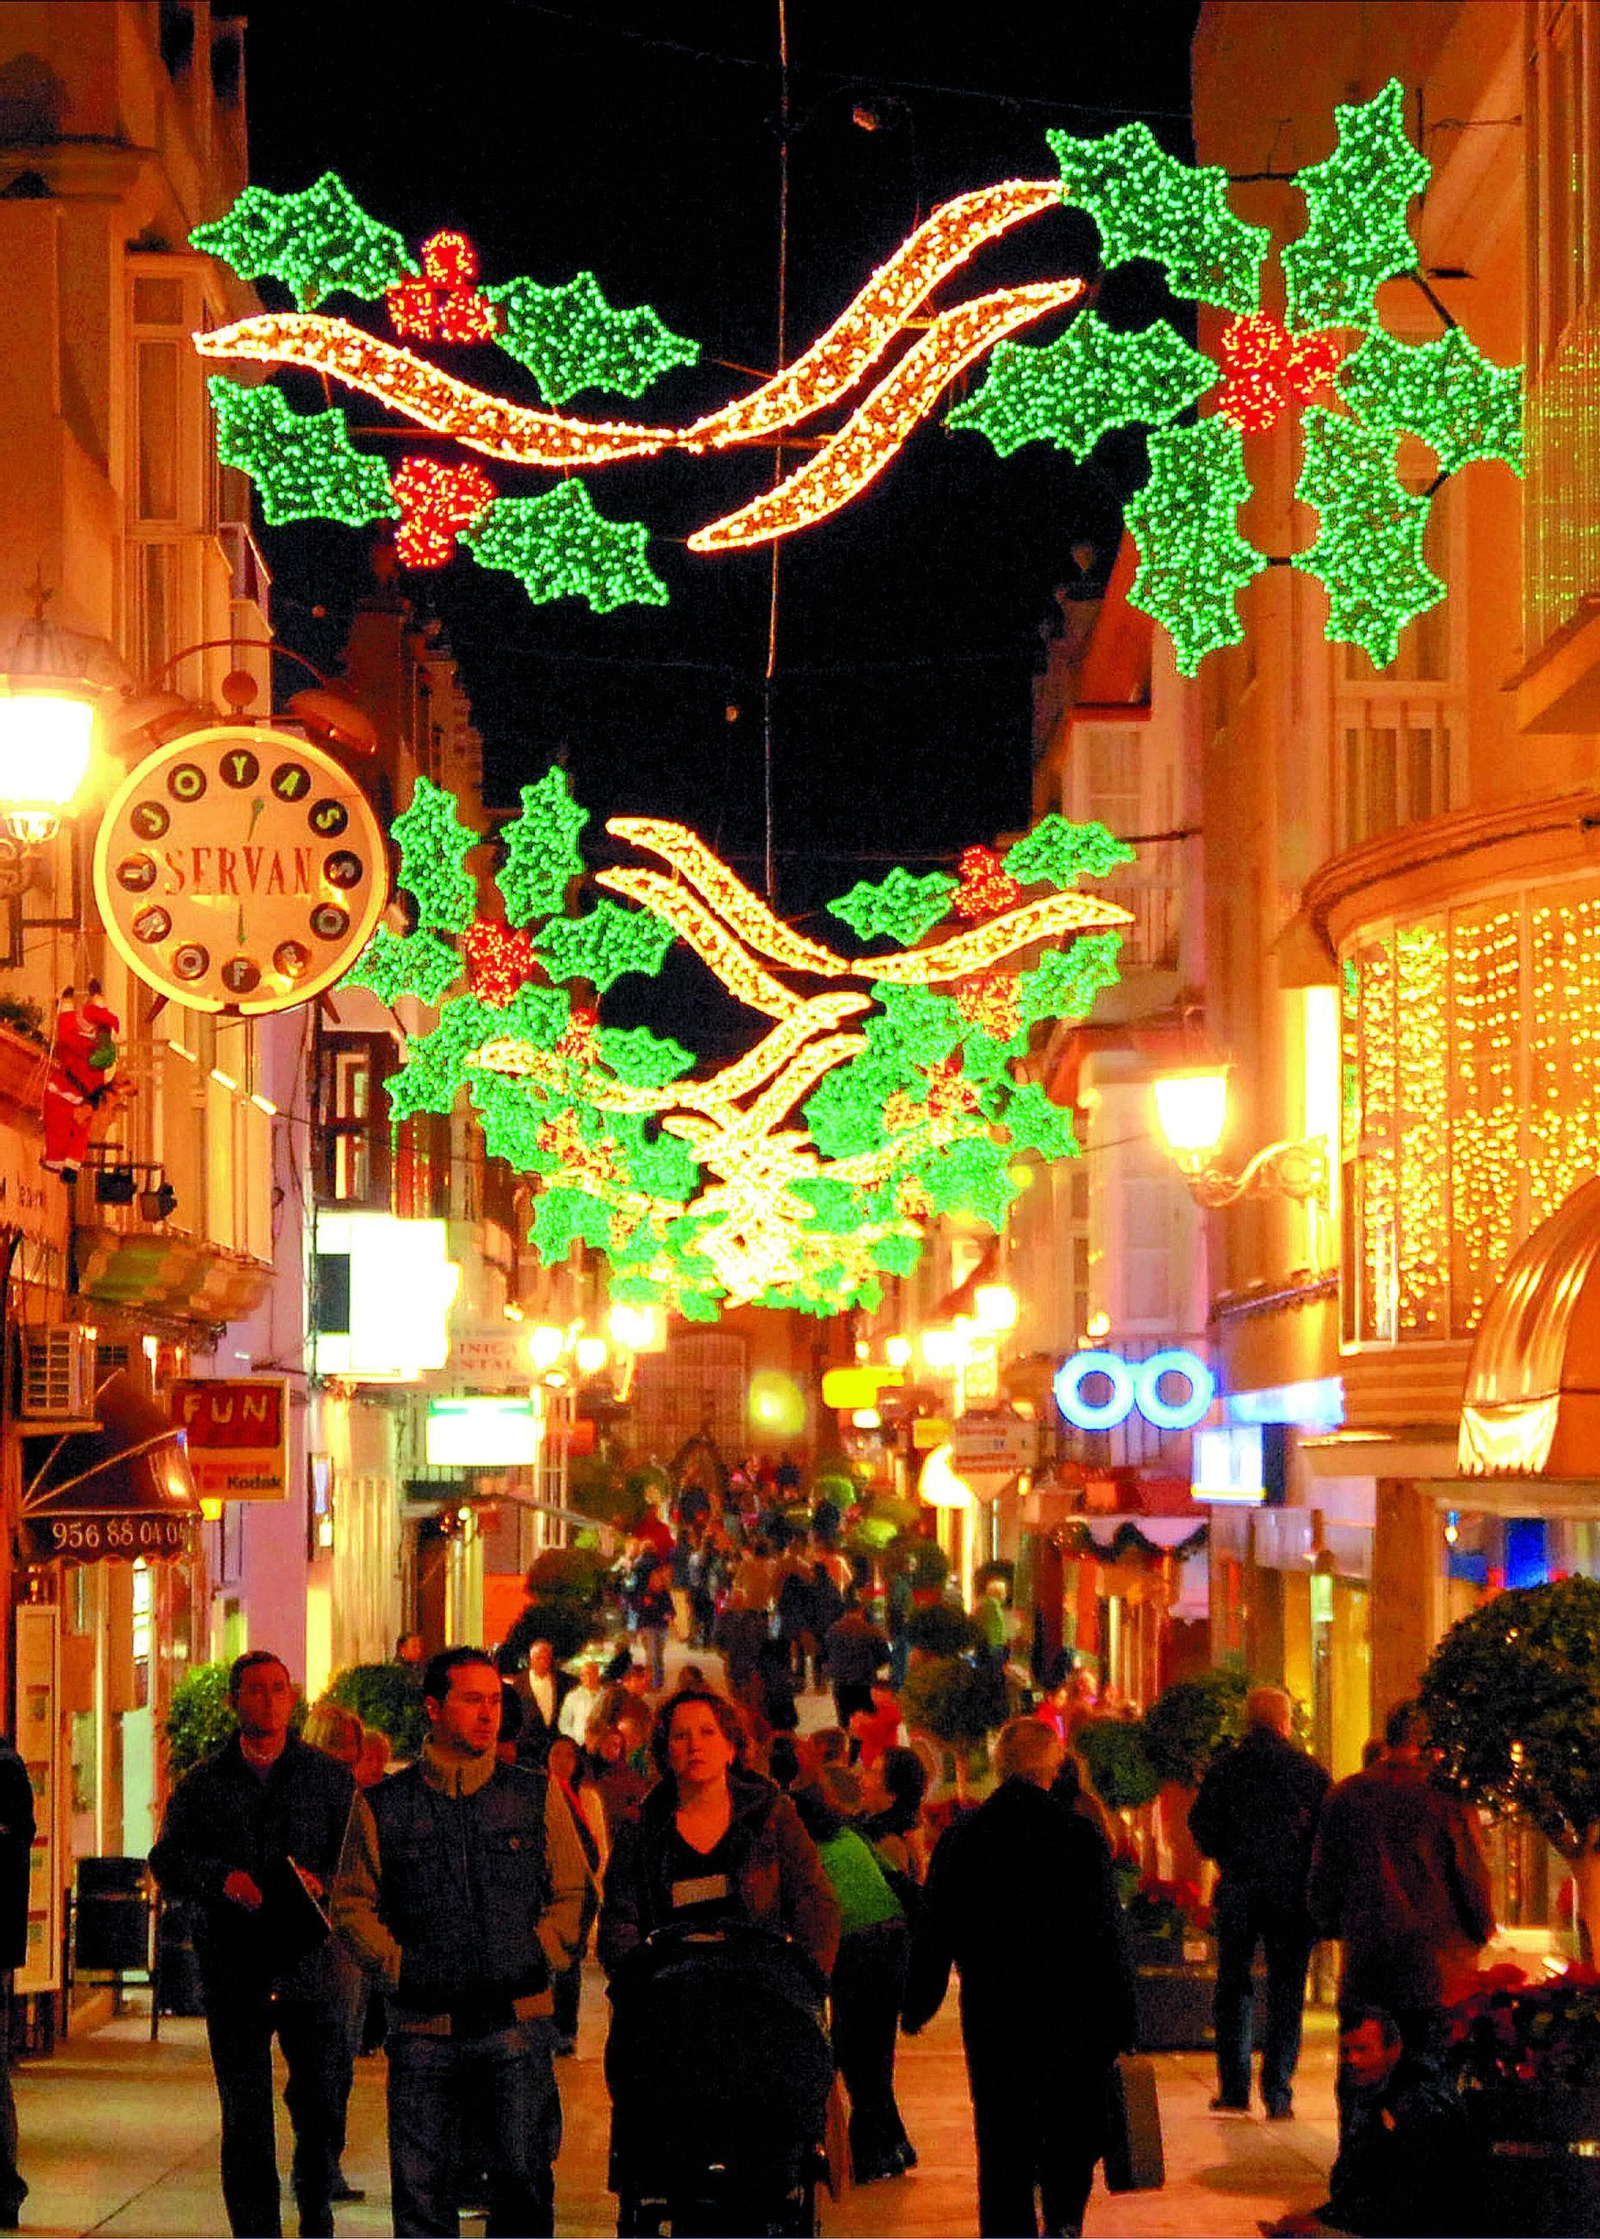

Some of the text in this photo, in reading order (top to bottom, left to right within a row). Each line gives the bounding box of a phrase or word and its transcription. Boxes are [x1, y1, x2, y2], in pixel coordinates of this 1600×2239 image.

[138, 753, 343, 834] JOYAS
[164, 846, 314, 896] SERVAN
[183, 1393, 268, 1424] FUN
[52, 1521, 100, 1550] 956
[106, 1517, 134, 1547] 88
